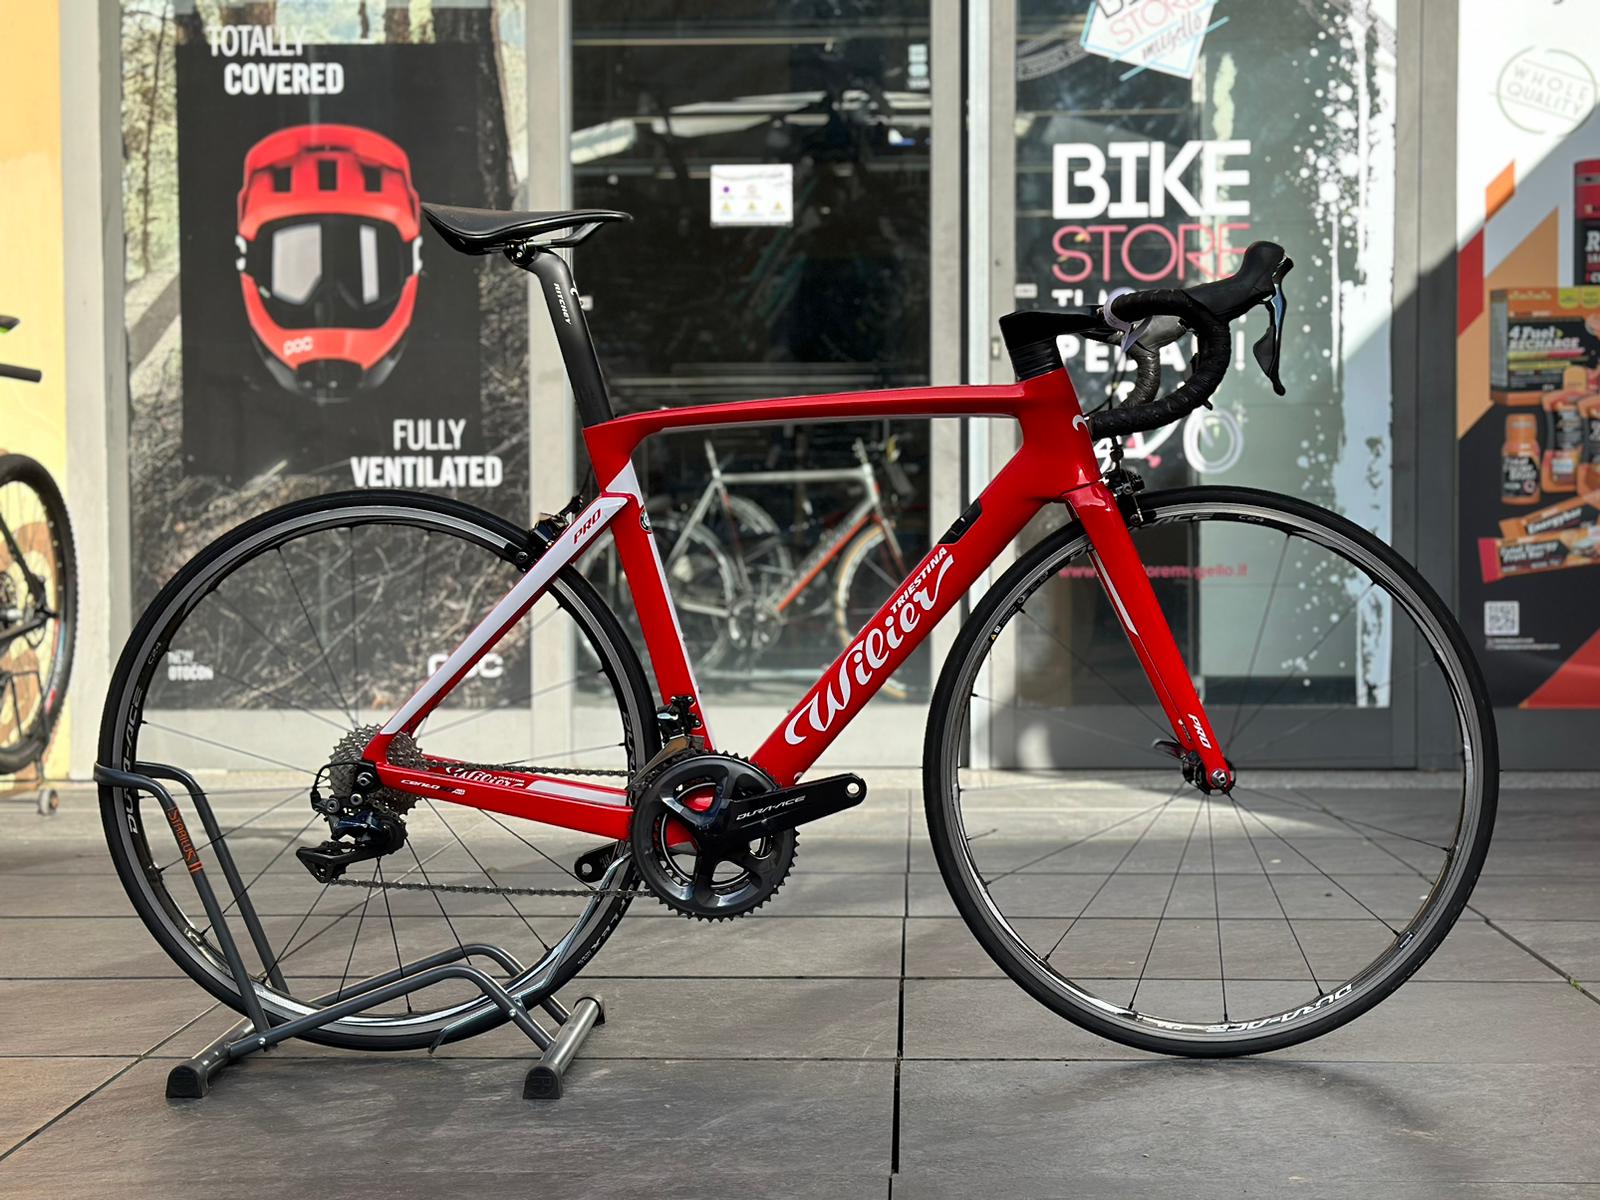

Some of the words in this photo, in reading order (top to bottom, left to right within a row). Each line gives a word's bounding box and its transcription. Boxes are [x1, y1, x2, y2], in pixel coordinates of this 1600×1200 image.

[207, 25, 305, 56] TOTALLY
[224, 63, 344, 95] COVERED
[1514, 64, 1589, 100] WHOLE
[1506, 81, 1583, 116] QUALITY
[1053, 140, 1251, 219] BIKE
[393, 418, 466, 451] FULLY
[350, 456, 503, 488] VENTILATED
[573, 508, 602, 544] PRO
[890, 547, 948, 614] TRIESTINA
[785, 554, 954, 745] Wilier
[1188, 713, 1212, 750] PRO
[736, 795, 807, 821] DURA-ACE
[1206, 983, 1353, 1033] DURA-ACE
